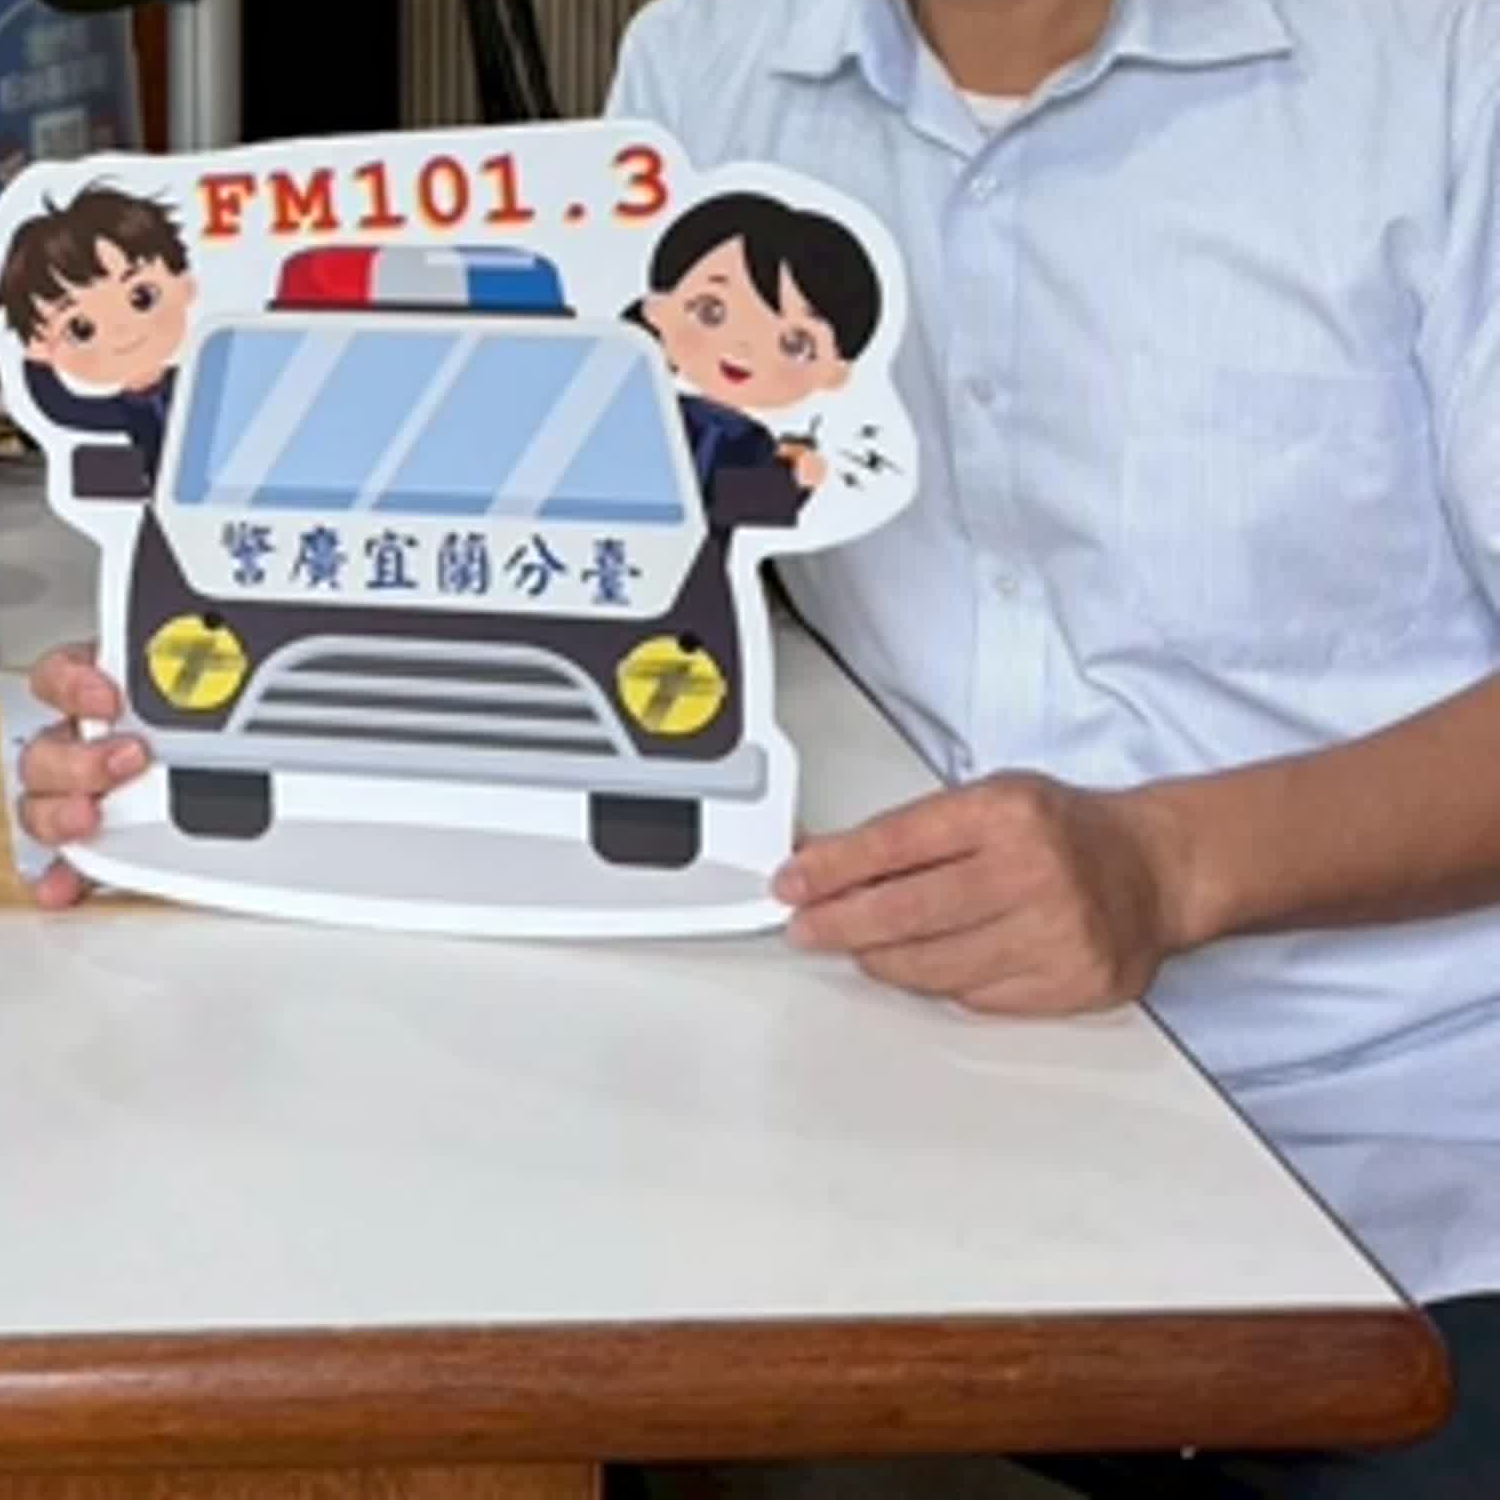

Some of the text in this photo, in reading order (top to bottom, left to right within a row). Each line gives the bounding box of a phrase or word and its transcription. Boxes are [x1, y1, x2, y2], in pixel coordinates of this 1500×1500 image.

[198, 145, 668, 238] FM101.3
[221, 522, 642, 606] 警廣宜蘭分臺
